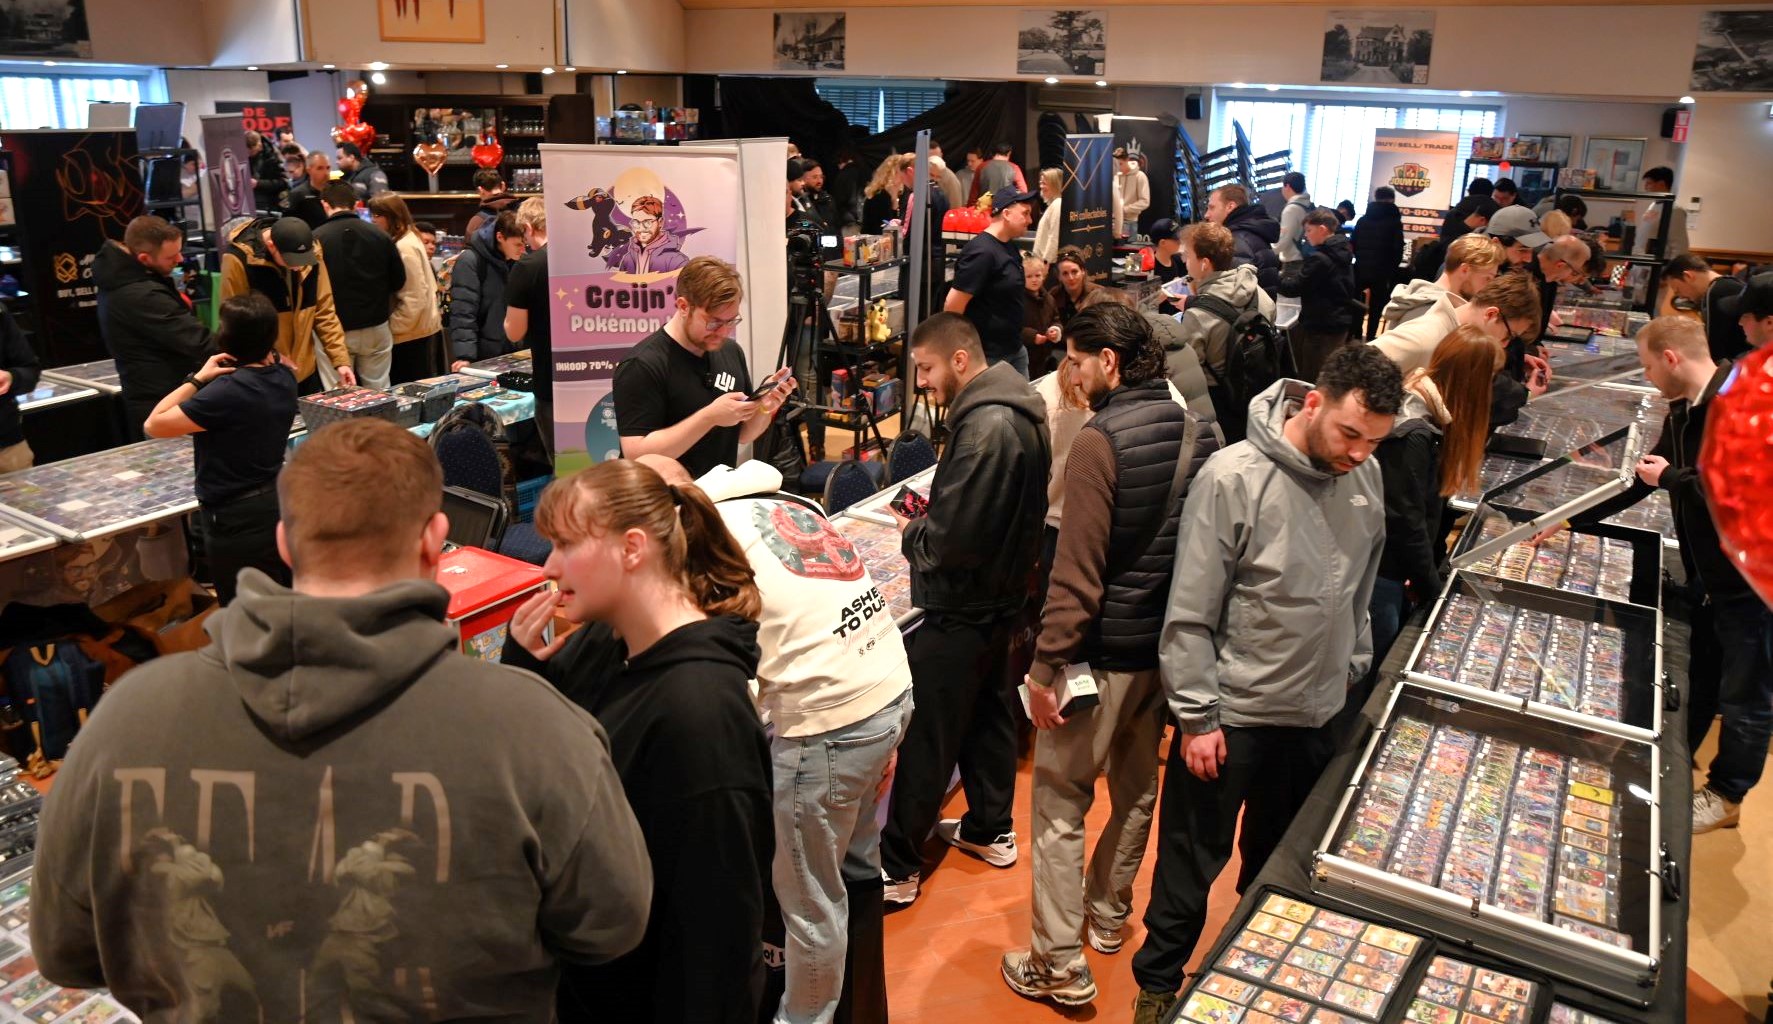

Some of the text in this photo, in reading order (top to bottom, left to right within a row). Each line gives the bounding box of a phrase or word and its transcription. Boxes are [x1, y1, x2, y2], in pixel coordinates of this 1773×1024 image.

[243, 107, 266, 117] DE
[1423, 143, 1454, 151] TRADE
[1389, 177, 1431, 188] JOUWTCG
[585, 282, 679, 313] Creijn'
[570, 313, 661, 333] Pokémon
[555, 362, 588, 372] INKOOP
[589, 360, 614, 371] 70%
[841, 586, 881, 622] ASHE
[832, 616, 861, 639] TO
